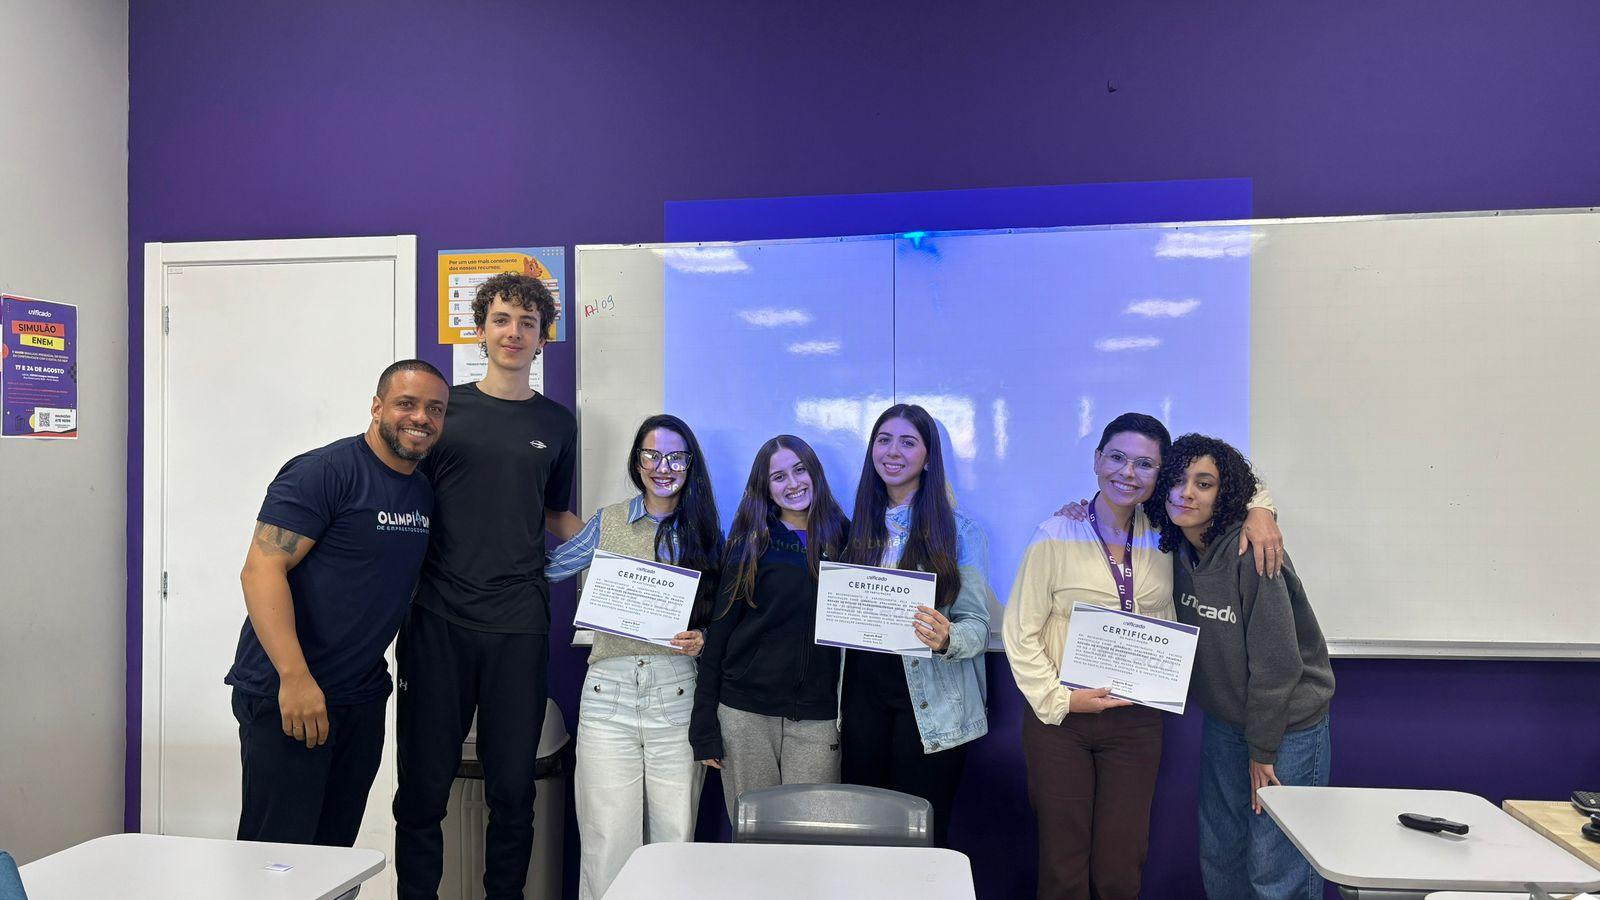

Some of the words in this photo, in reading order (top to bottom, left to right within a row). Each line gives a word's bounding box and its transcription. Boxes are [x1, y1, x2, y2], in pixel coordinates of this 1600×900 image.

[28, 309, 52, 318] unificado
[18, 323, 57, 334] SIMULÃO
[31, 336, 54, 347] ENEM
[617, 570, 675, 588] CERTIFICADO
[848, 581, 910, 595] CERTIFICADO
[1102, 624, 1169, 645] CERTIFICADO
